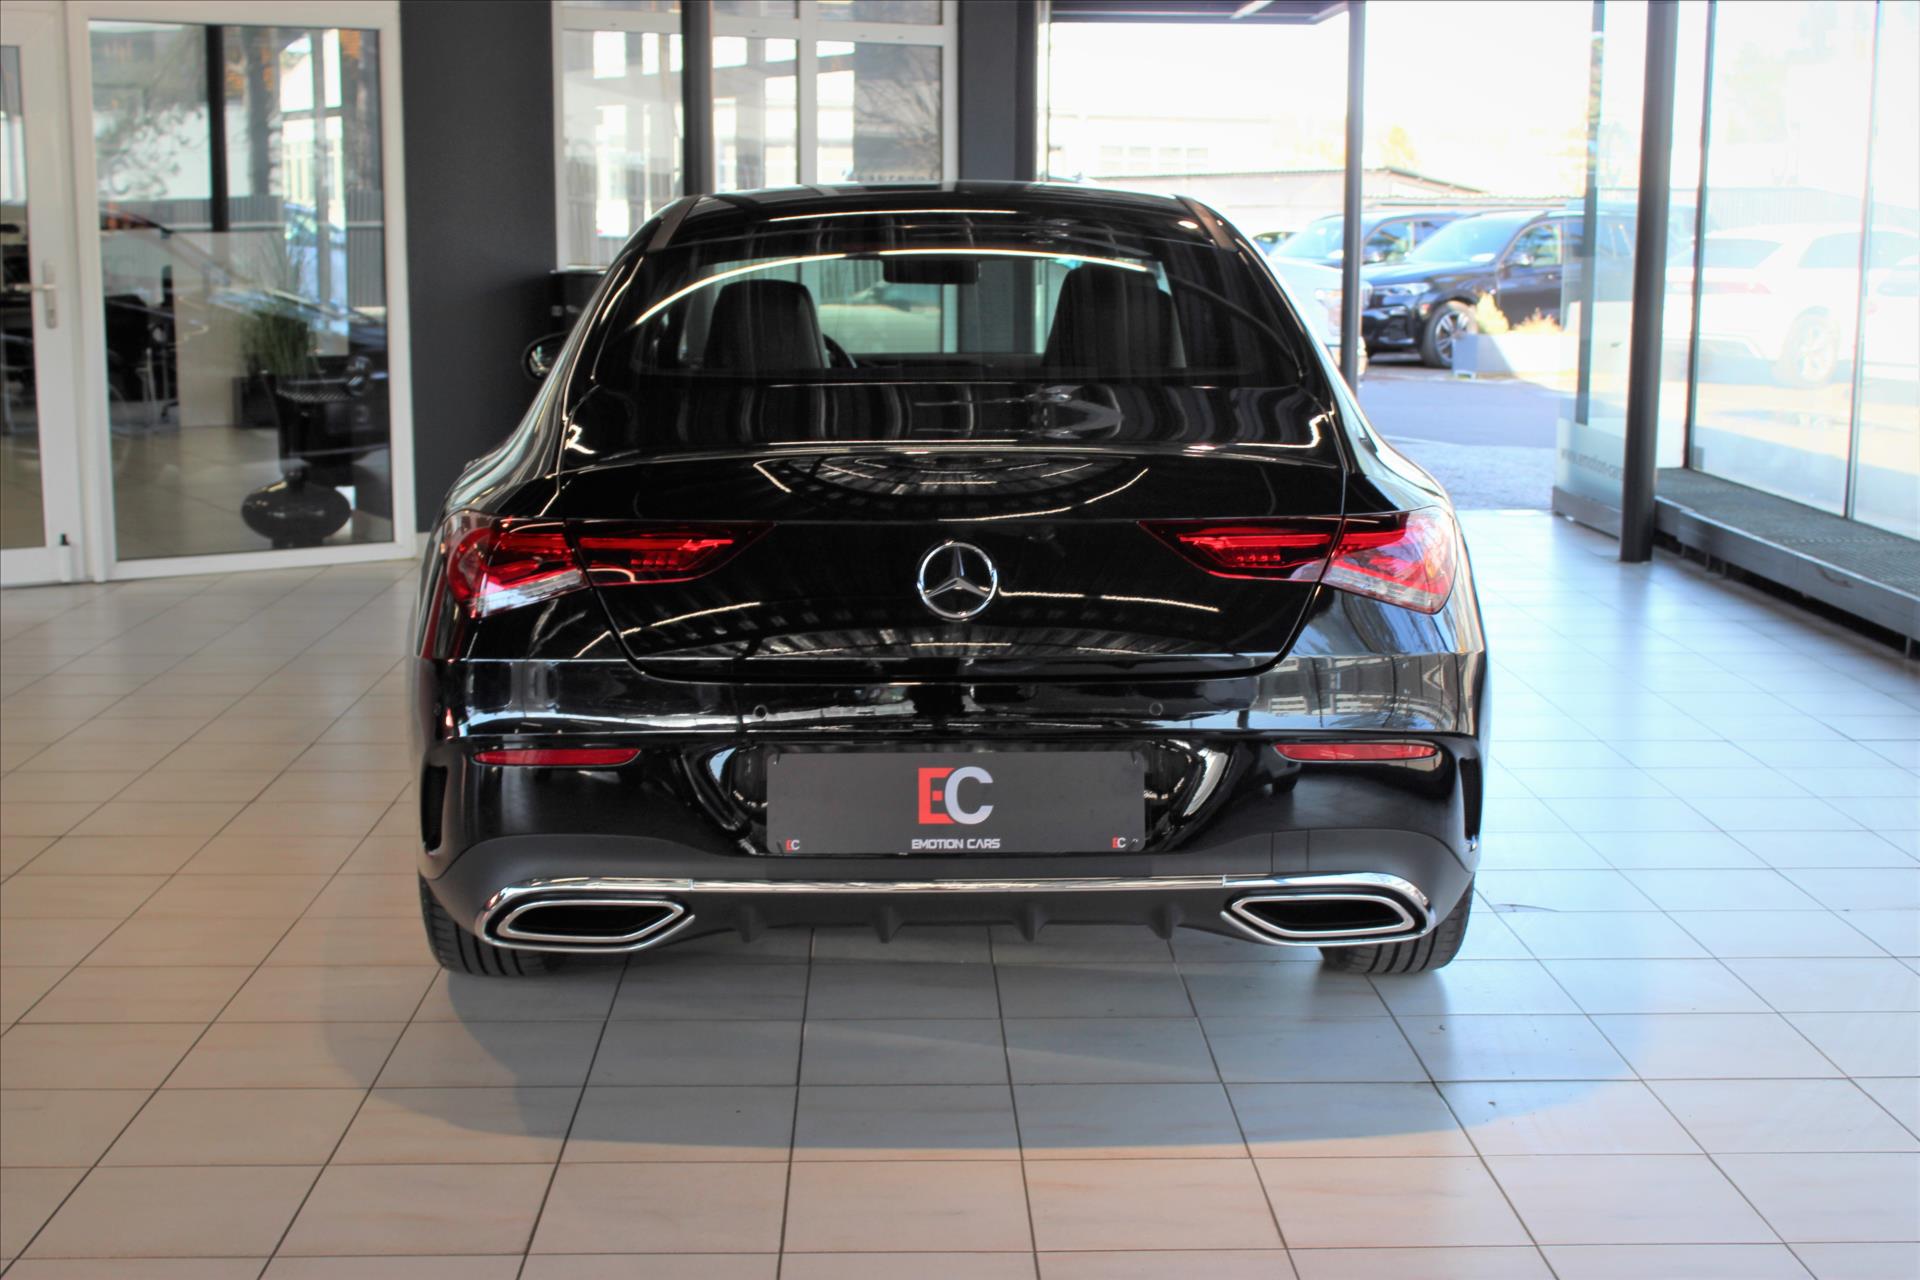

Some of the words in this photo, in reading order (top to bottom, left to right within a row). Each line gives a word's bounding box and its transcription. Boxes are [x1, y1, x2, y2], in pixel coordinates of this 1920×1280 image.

[918, 766, 994, 824] EC
[911, 838, 964, 849] EMOTION
[966, 838, 1001, 849] CARS
